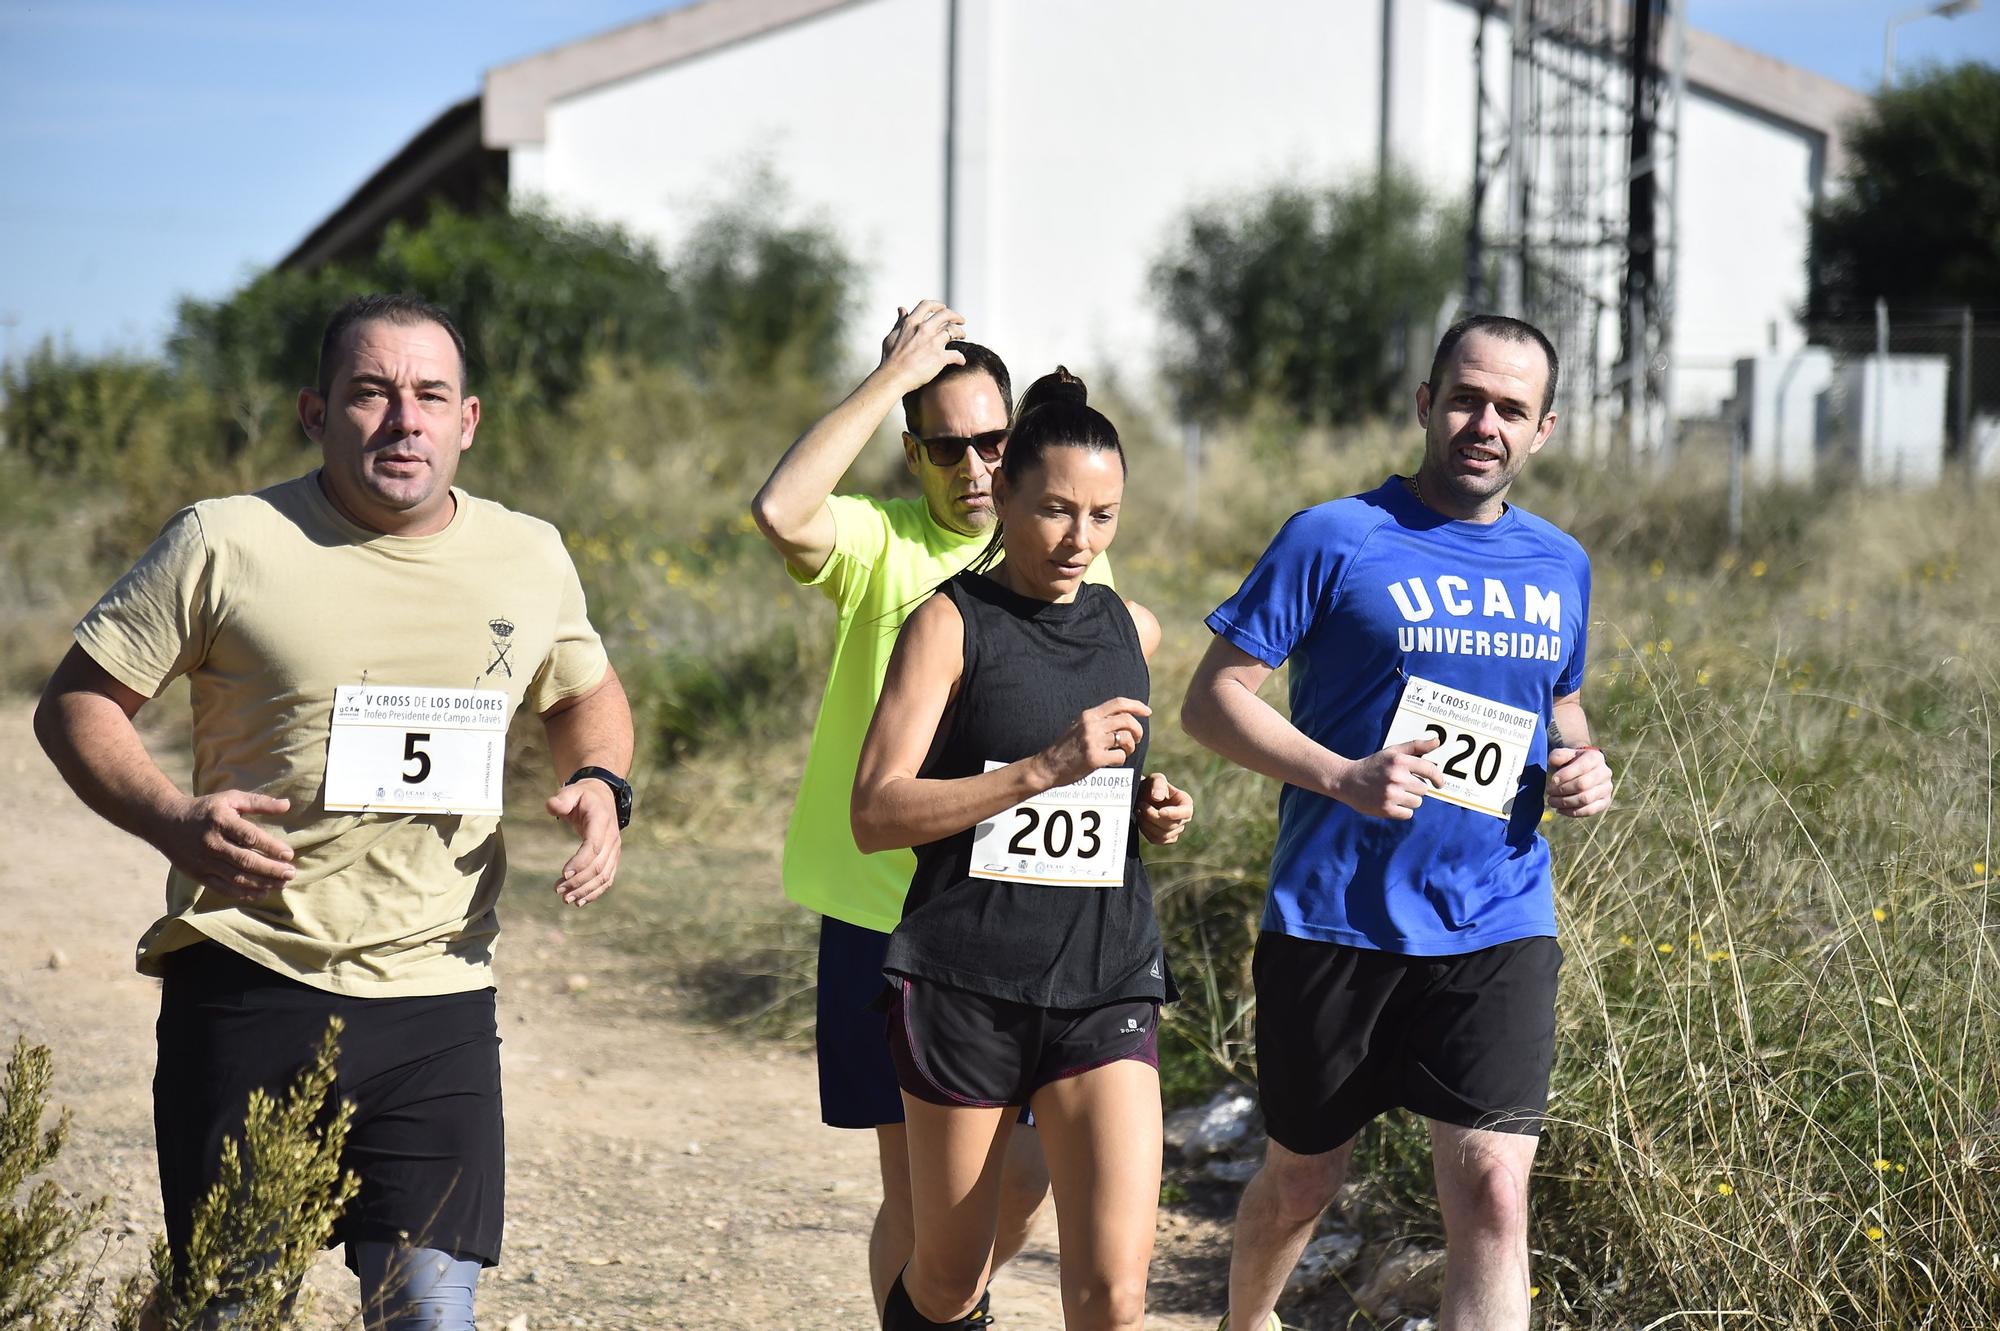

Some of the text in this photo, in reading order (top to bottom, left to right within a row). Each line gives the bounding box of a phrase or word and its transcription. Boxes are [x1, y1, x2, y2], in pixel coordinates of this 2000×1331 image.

[1387, 575, 1561, 632] UCAM
[1398, 627, 1562, 662] UNIVERSIDAD
[364, 709, 387, 720] Trofeo
[389, 710, 430, 722] Presidente
[432, 711, 442, 722] de
[443, 712, 471, 724] Campo
[366, 695, 503, 711] V CROSS DE LOS DOLORES
[1427, 702, 1447, 717] Trofeo
[1448, 707, 1480, 727] Presidente
[1432, 690, 1533, 730] V CROSS DE LOS DOLORES
[402, 733, 431, 784] 5
[1039, 789, 1072, 799] residente
[1090, 776, 1130, 788] DOLORES
[1008, 807, 1101, 859] 203
